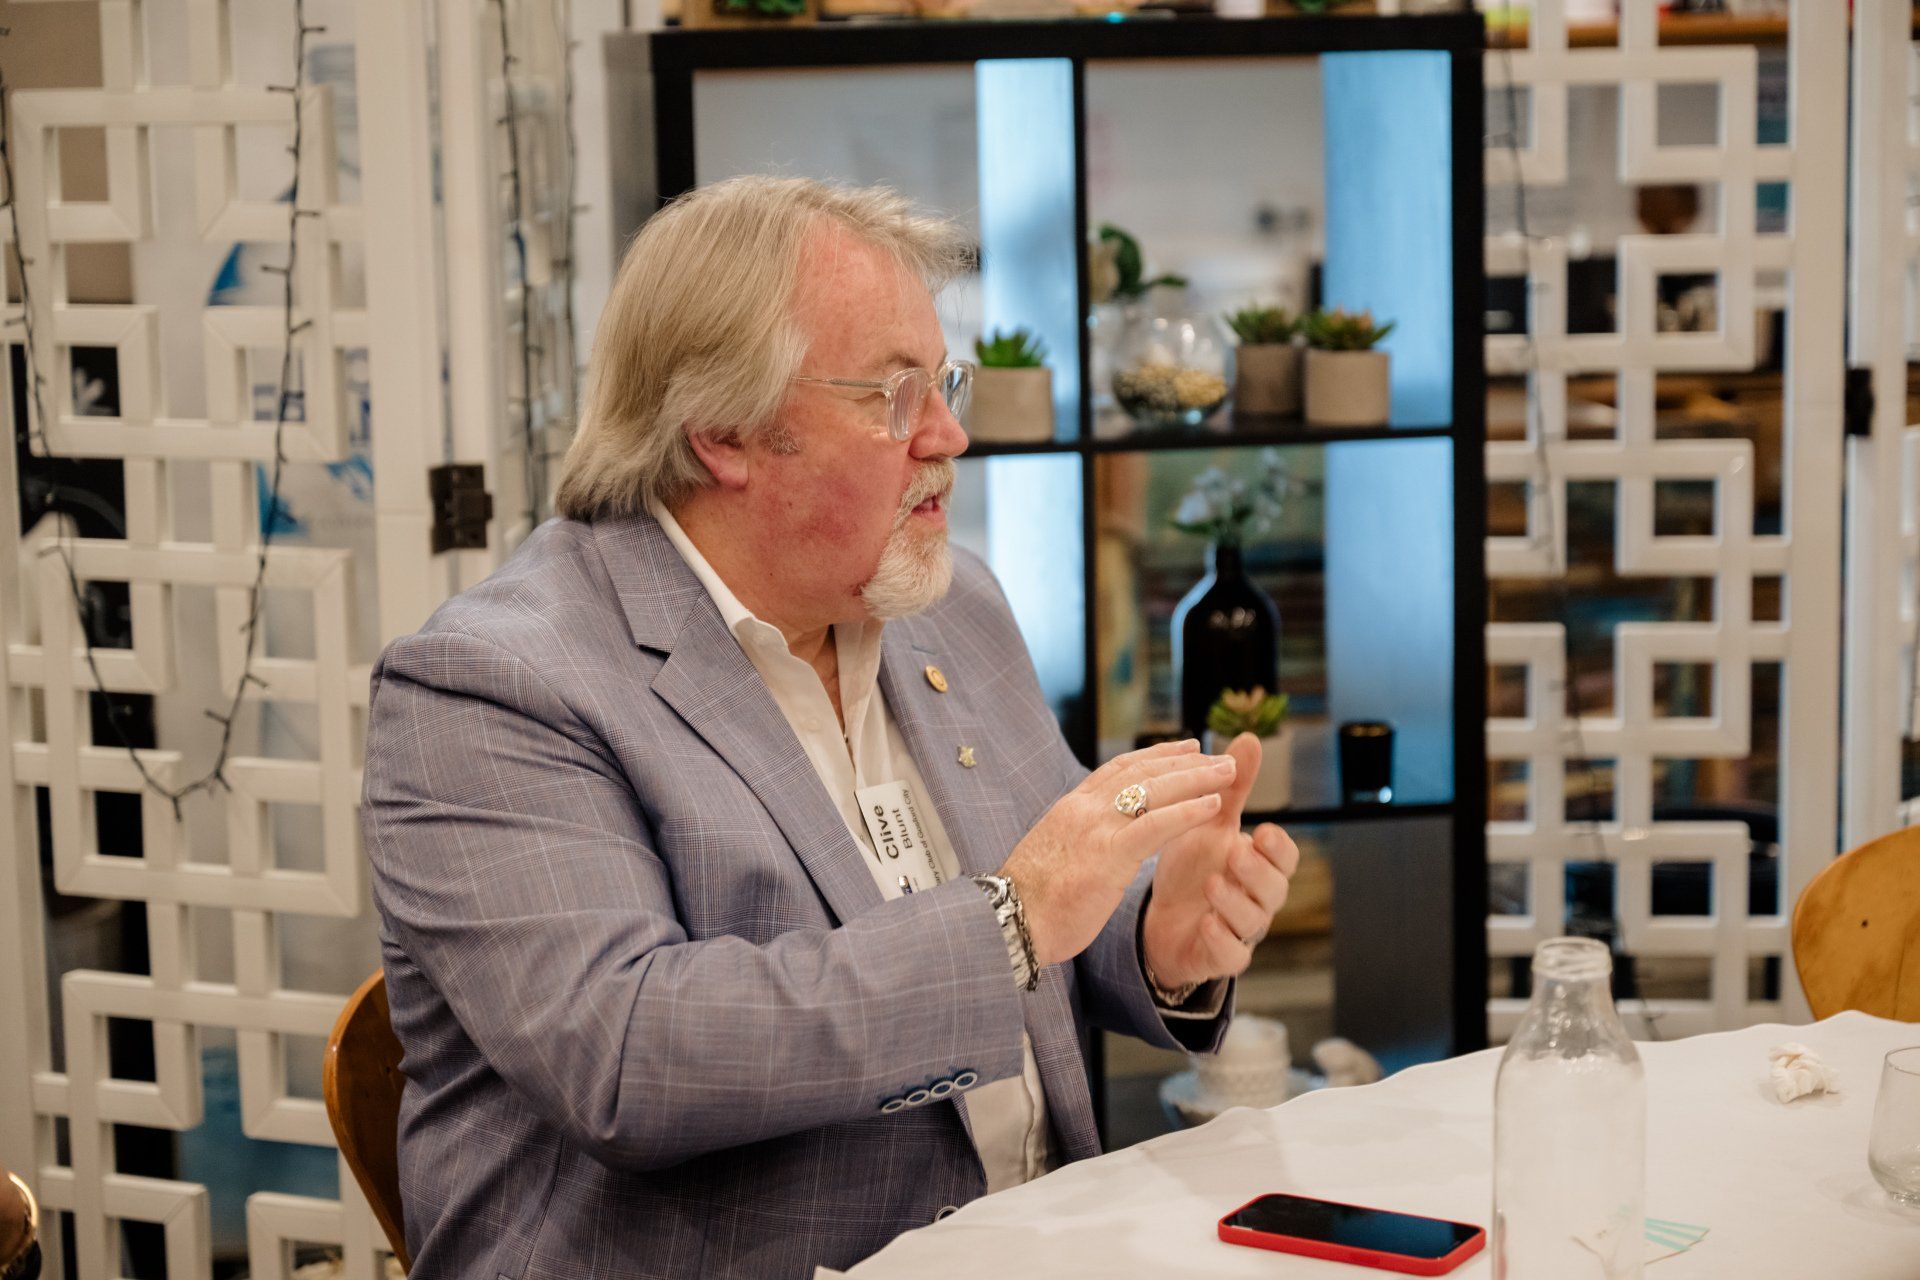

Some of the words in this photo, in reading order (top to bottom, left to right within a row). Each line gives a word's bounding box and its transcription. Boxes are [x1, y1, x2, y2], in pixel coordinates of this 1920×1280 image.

[902, 788, 912, 805] City
[874, 804, 899, 859] Clive
[892, 807, 913, 849] Blunt
[921, 839, 928, 848] of
[925, 849, 936, 869] Club
